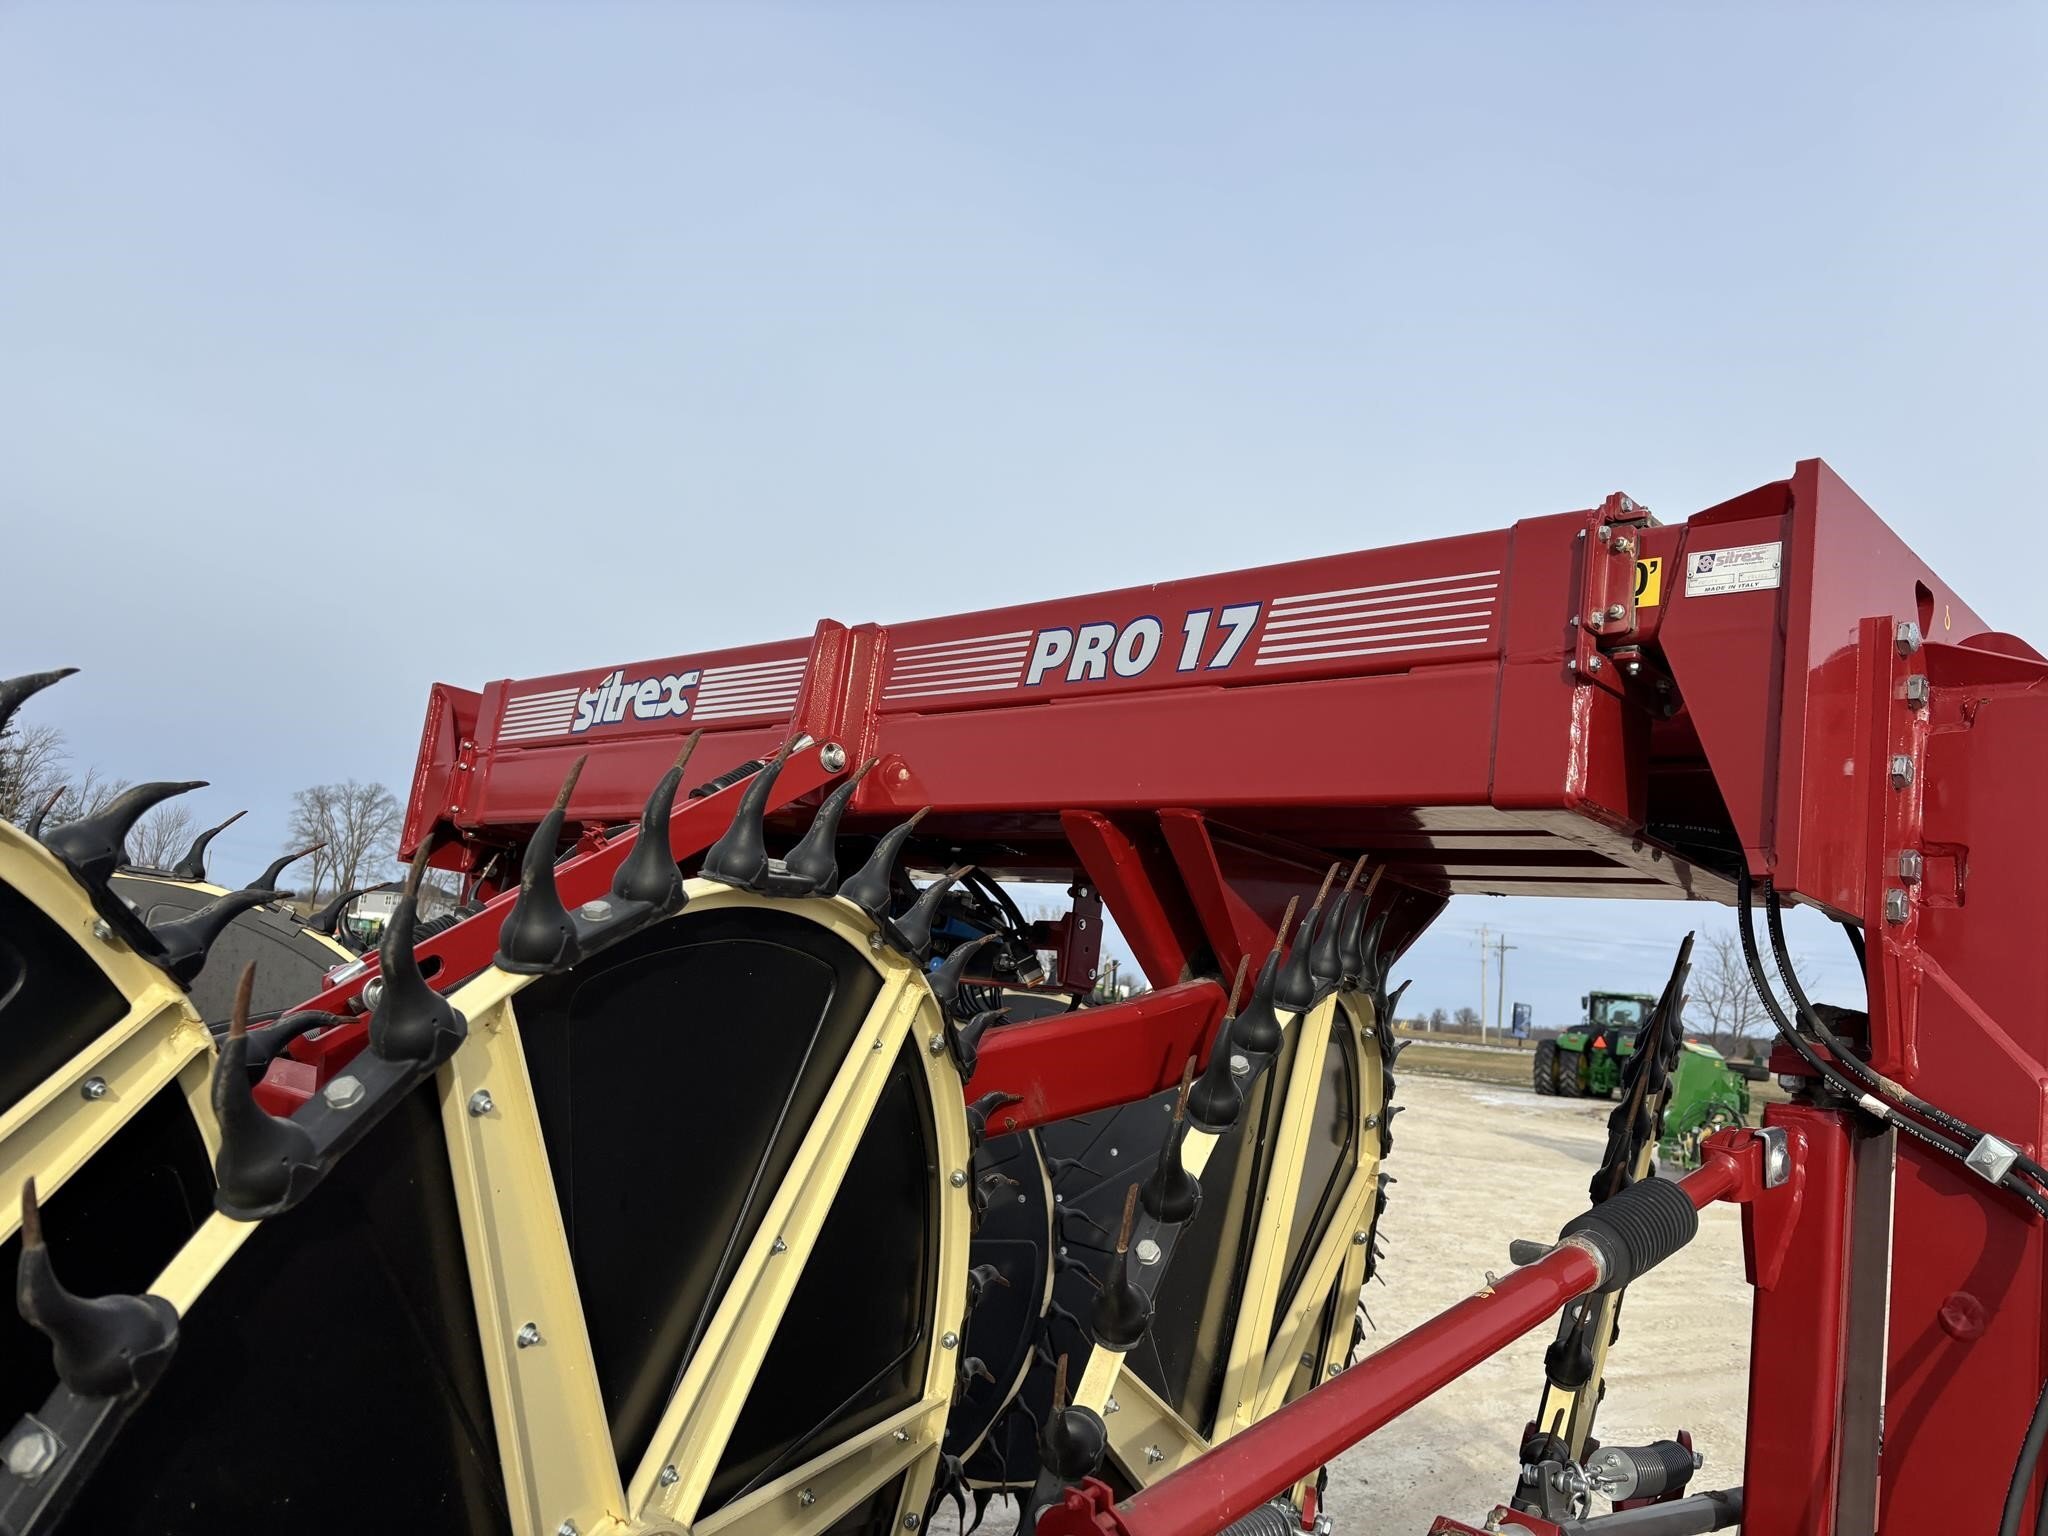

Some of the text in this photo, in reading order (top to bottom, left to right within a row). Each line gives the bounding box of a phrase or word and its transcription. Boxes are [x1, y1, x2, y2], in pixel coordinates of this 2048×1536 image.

[1023, 601, 1264, 687] PRO 17
[571, 669, 701, 734] sitrex
[1824, 1074, 1834, 1083] EN
[1892, 1118, 1905, 1128] WP
[1905, 1126, 1919, 1137] 225
